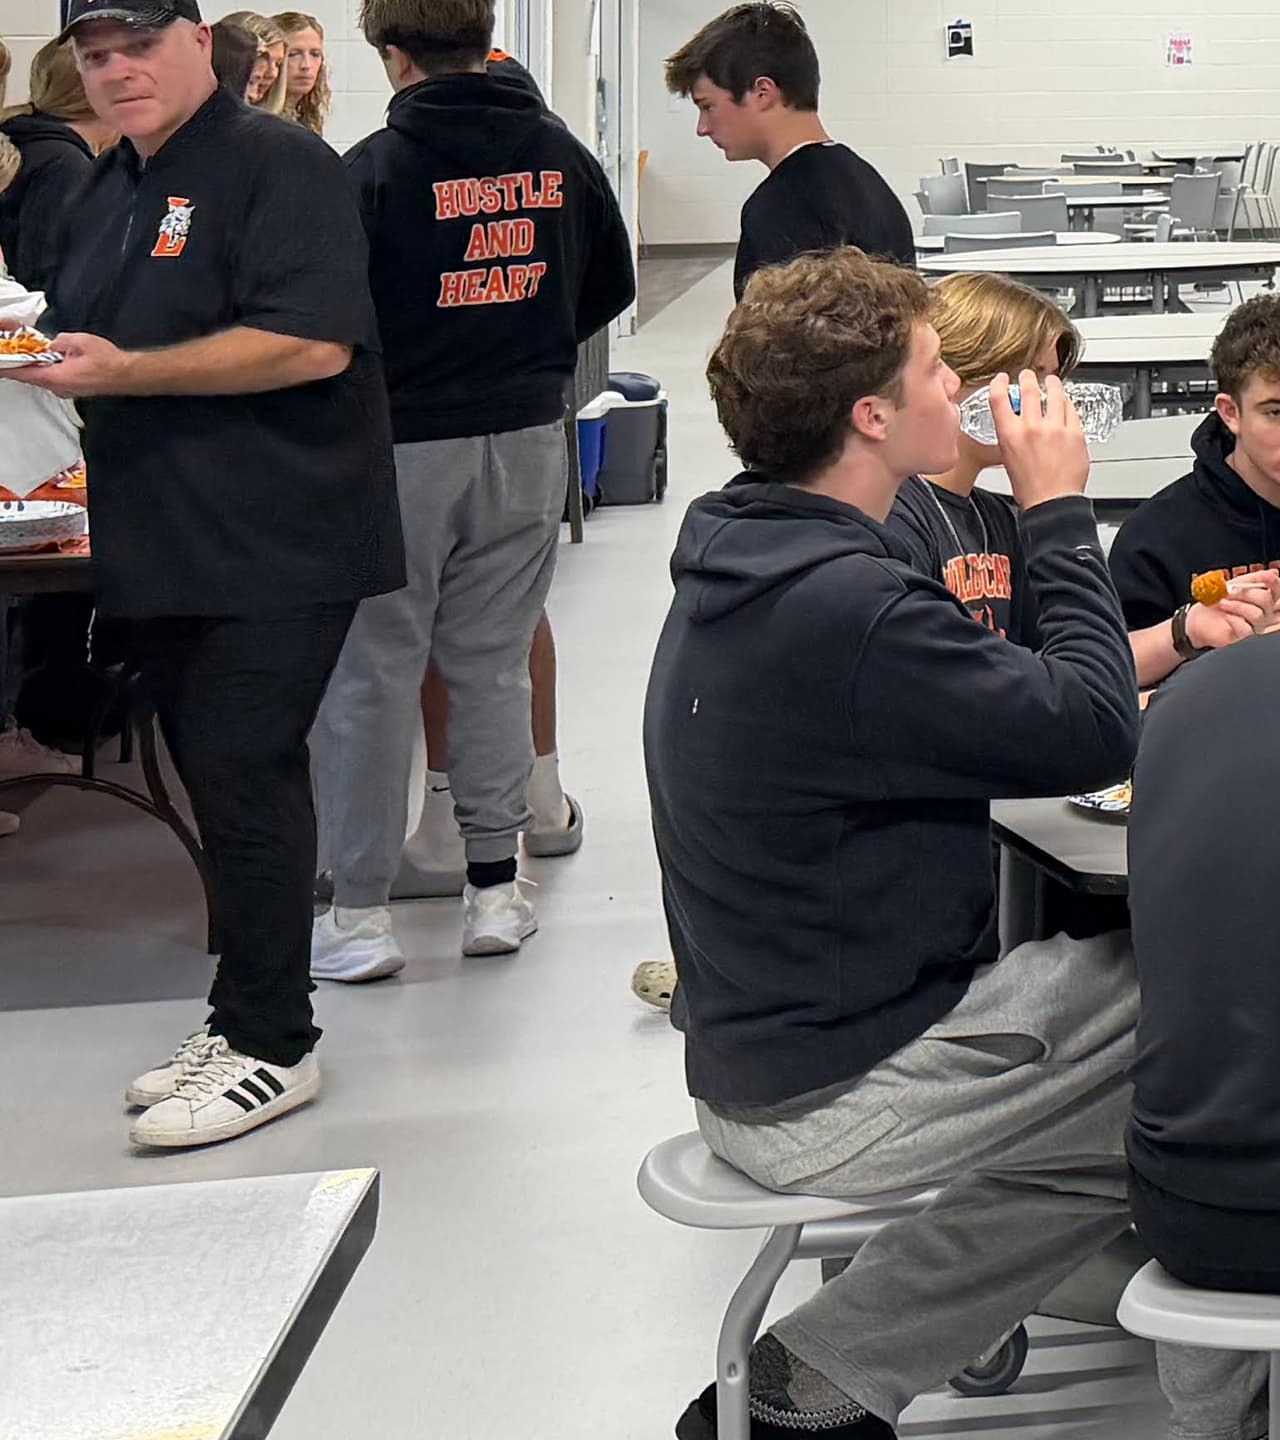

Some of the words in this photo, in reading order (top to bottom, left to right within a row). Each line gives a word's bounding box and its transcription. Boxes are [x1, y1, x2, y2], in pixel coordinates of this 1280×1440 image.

[432, 170, 563, 220] HUSTLE
[463, 218, 535, 261] AND
[437, 262, 547, 307] HEART
